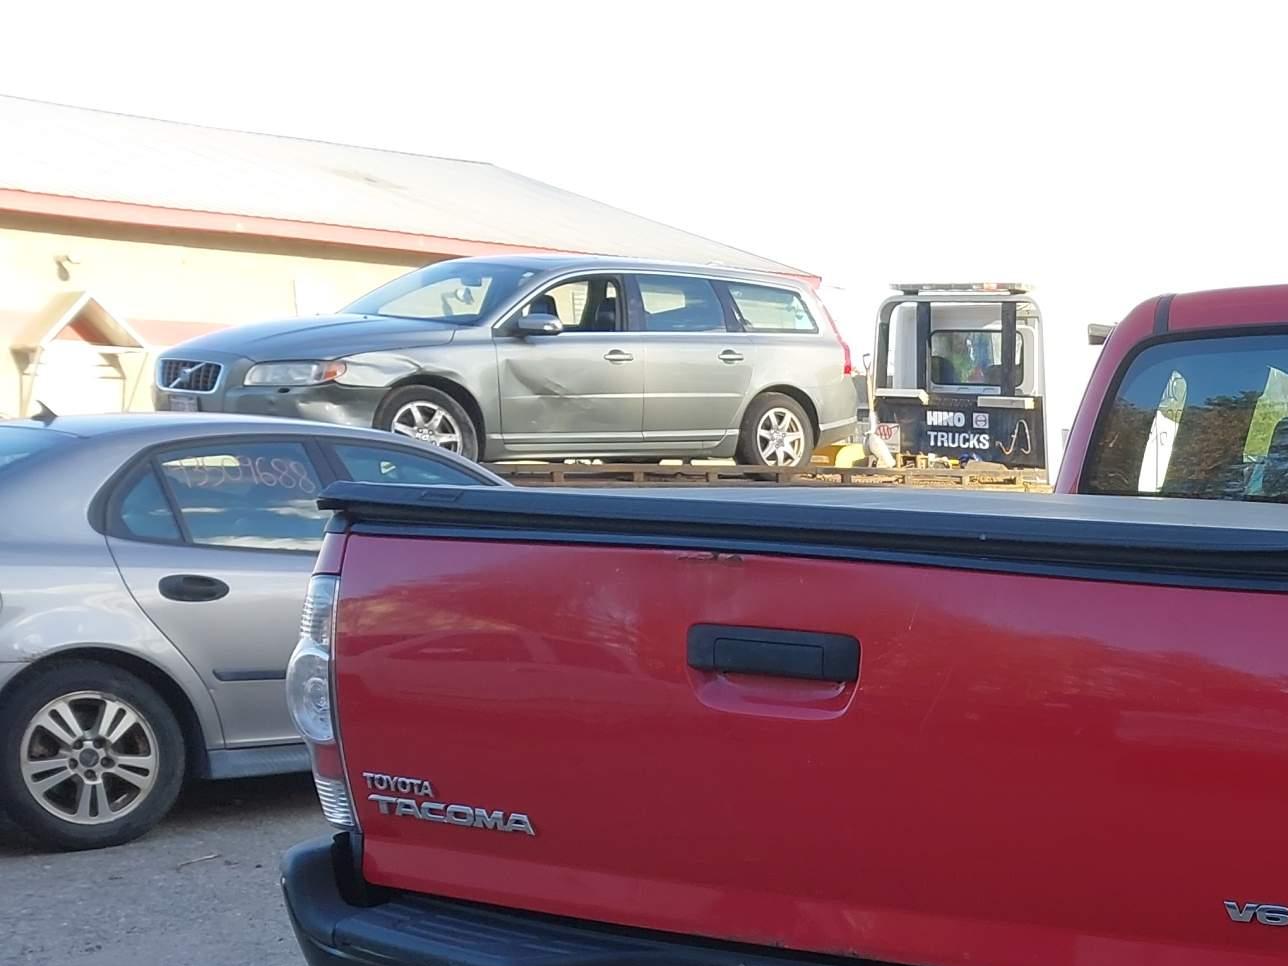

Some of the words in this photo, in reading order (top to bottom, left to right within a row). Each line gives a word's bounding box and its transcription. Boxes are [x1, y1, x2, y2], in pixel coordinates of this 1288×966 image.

[926, 411, 965, 427] HINO
[928, 431, 990, 449] TRUCKS
[362, 772, 434, 798] TOYOTA
[368, 794, 536, 836] TACOMA
